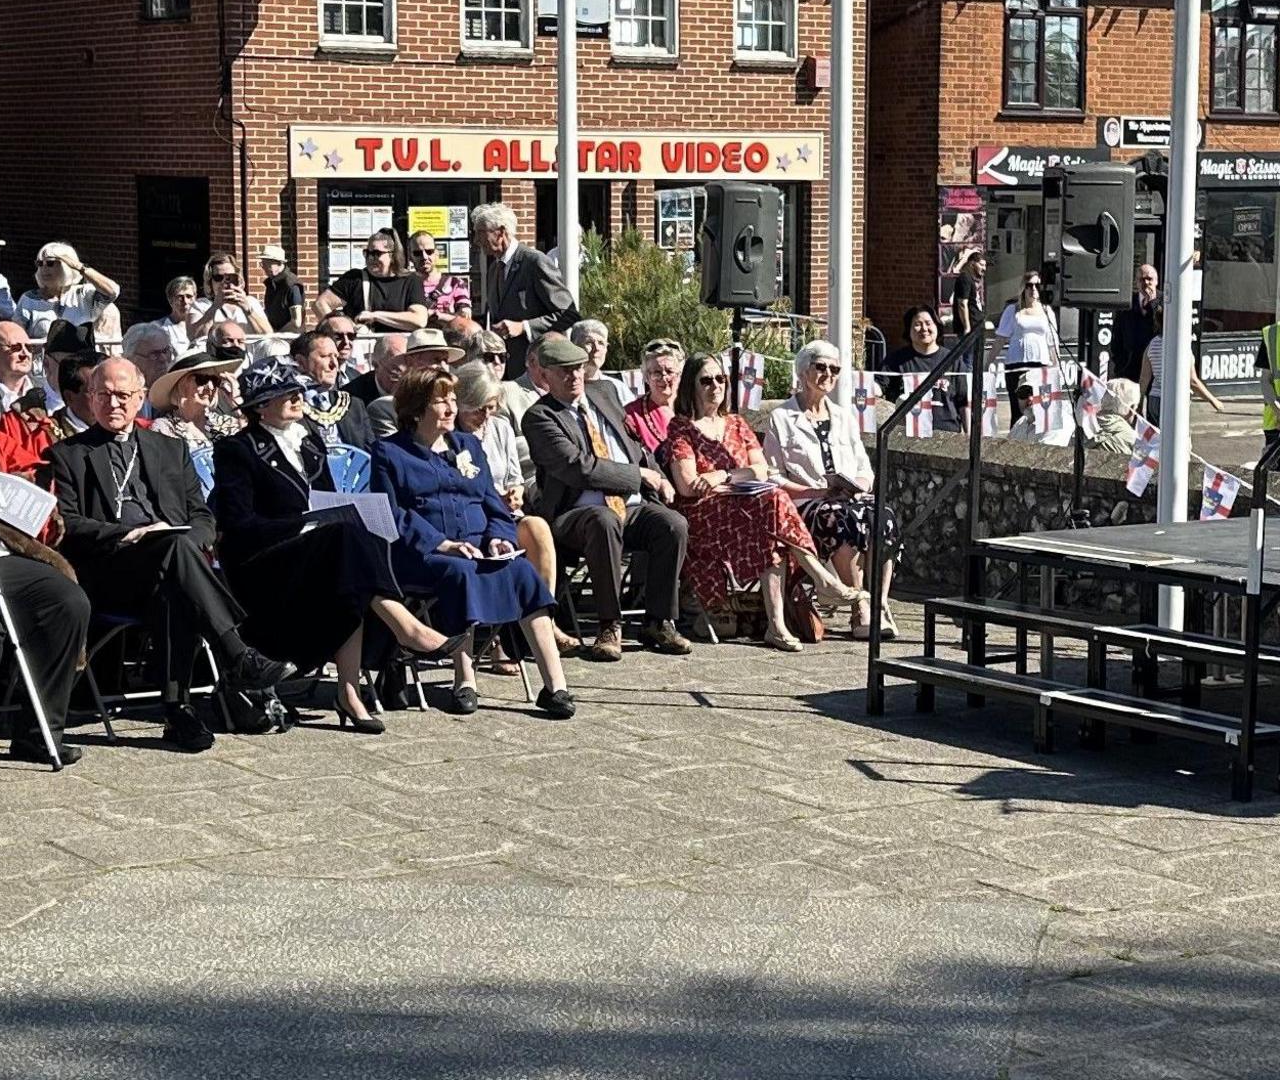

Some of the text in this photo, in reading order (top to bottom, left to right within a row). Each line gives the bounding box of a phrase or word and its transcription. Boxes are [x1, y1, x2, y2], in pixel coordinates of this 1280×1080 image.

[355, 137, 770, 174] T.V.L. ALLTAR VIDEO
[1007, 154, 1047, 176] Magic
[1200, 159, 1235, 180] Magic
